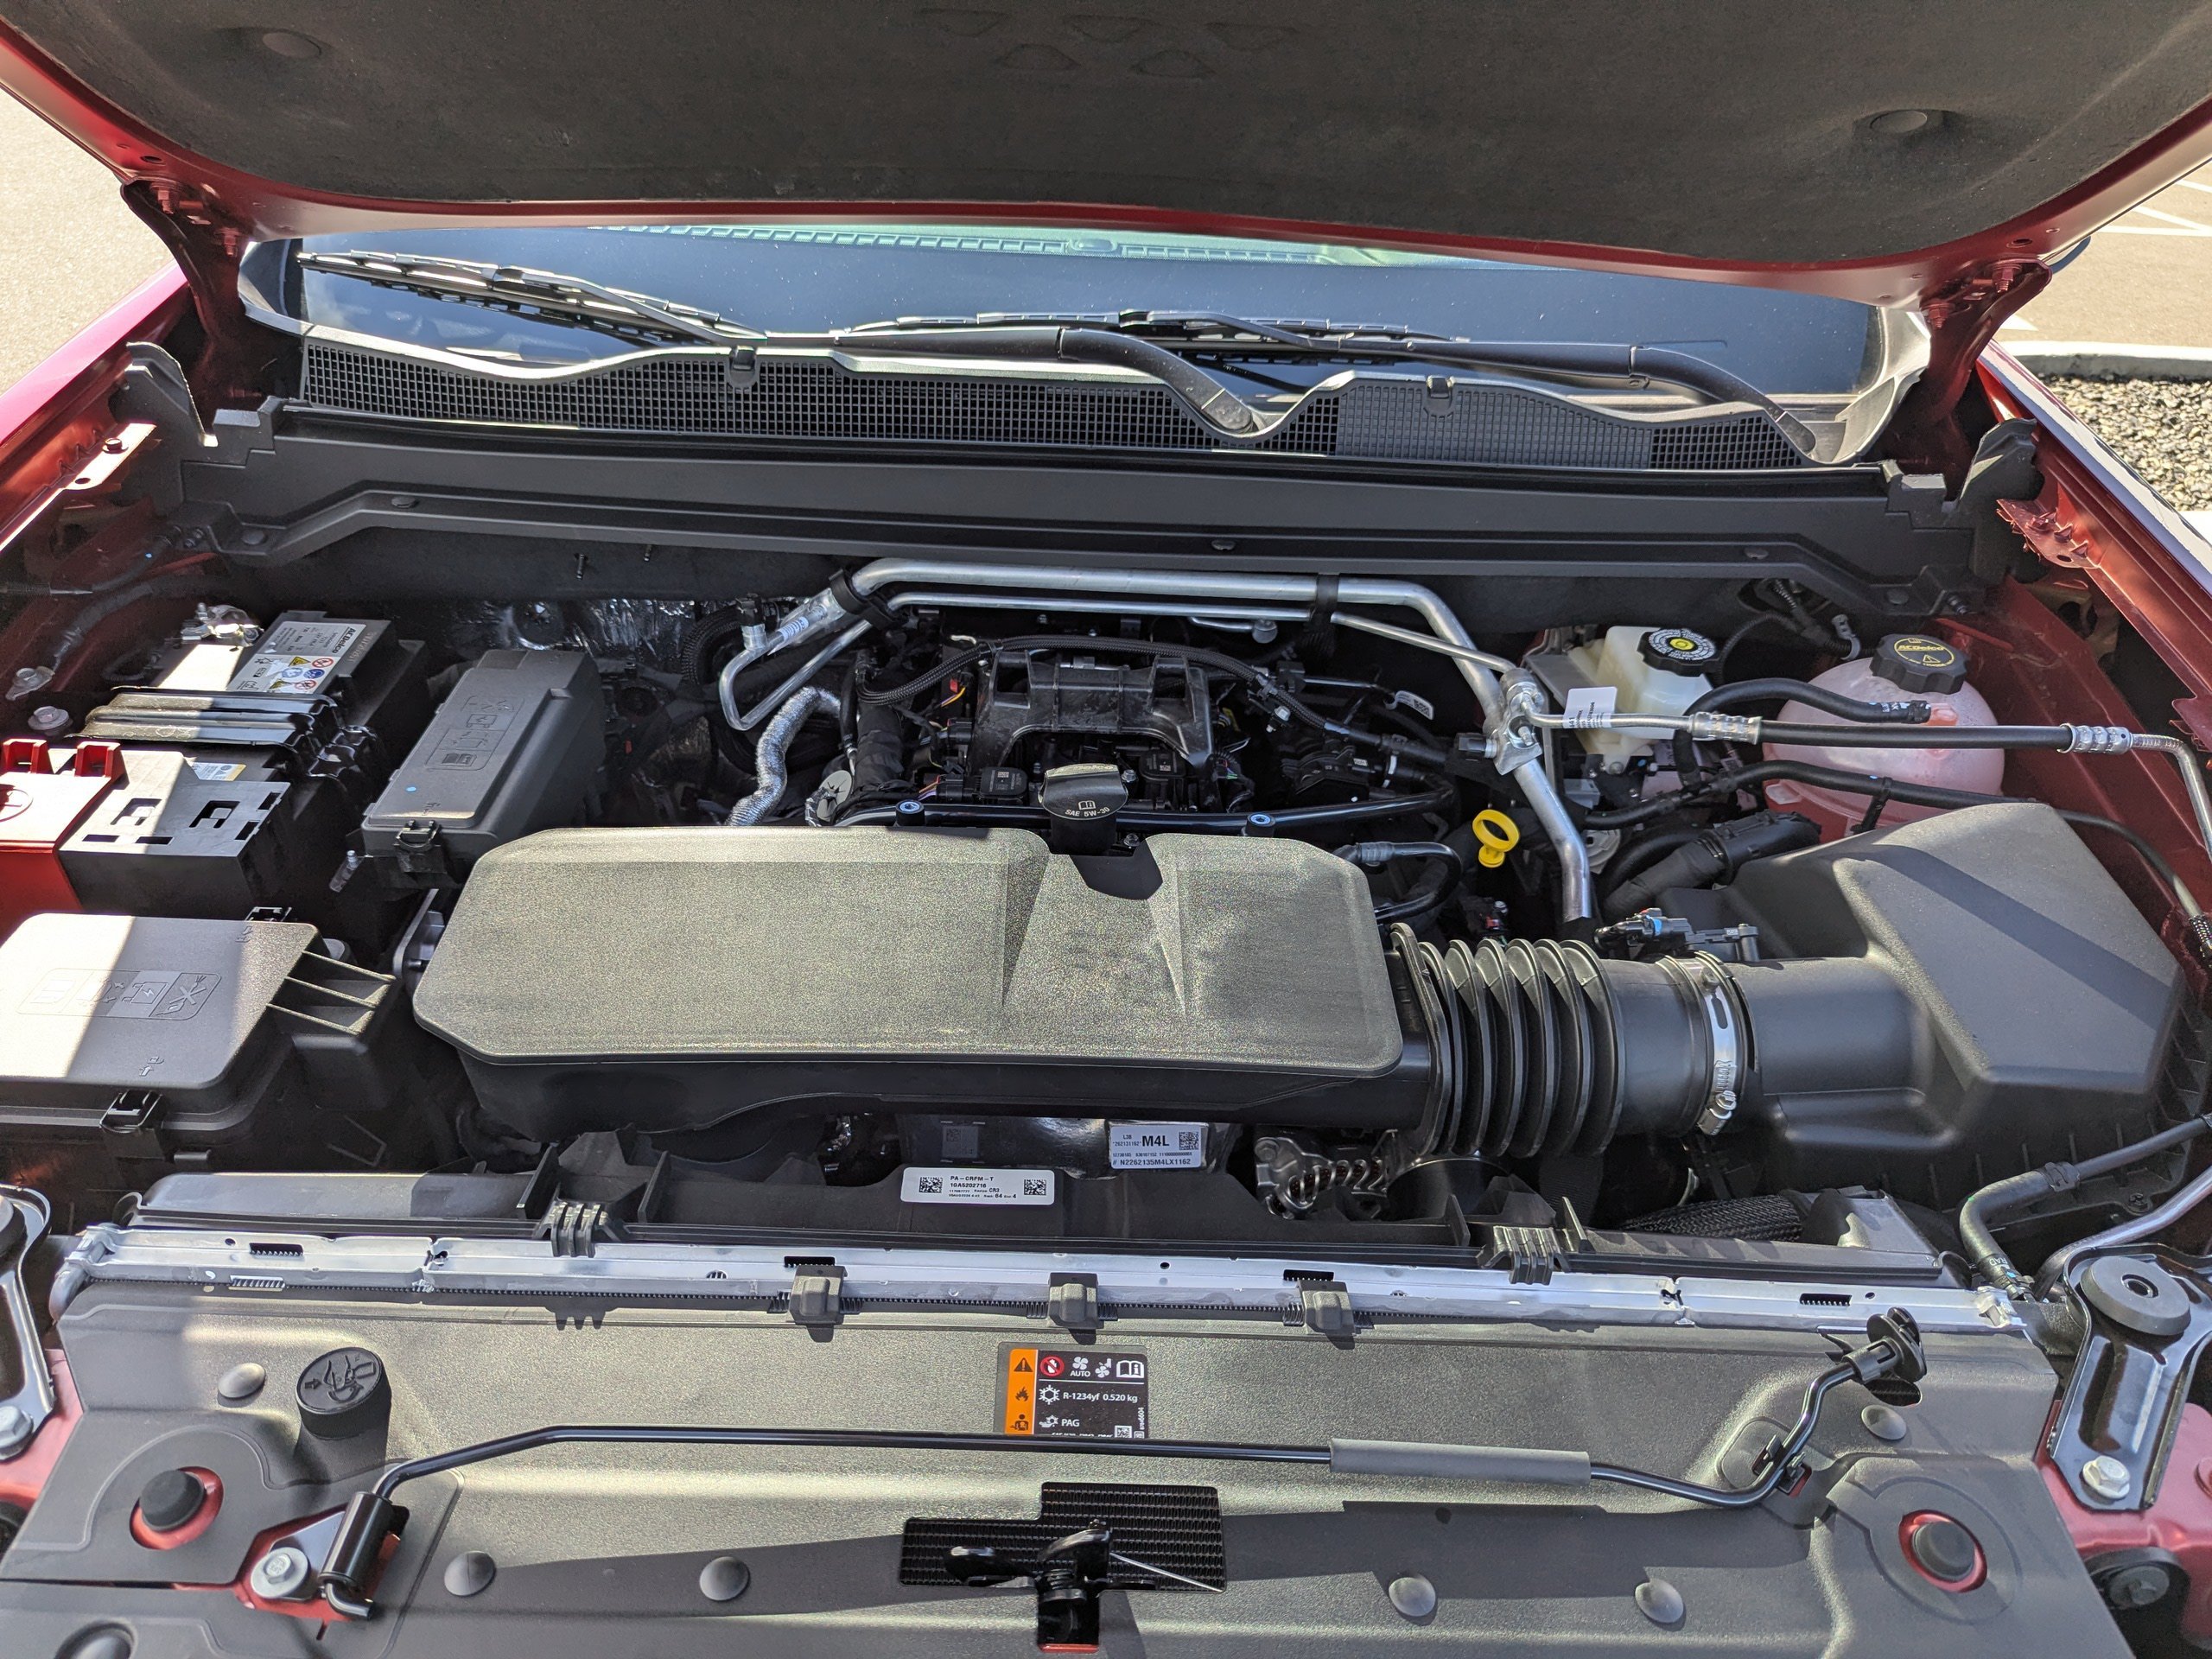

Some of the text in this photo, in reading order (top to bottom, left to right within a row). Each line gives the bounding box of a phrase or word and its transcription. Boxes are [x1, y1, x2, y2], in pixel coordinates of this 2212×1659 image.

[1084, 807, 1110, 817] 5W-30
[1142, 1135, 1170, 1147] M4L
[1989, 1257, 2008, 1266] RAD
[1063, 1393, 1100, 1402] R-1234yf
[1128, 1394, 1138, 1403] kg
[1061, 1418, 1080, 1427] PAG
